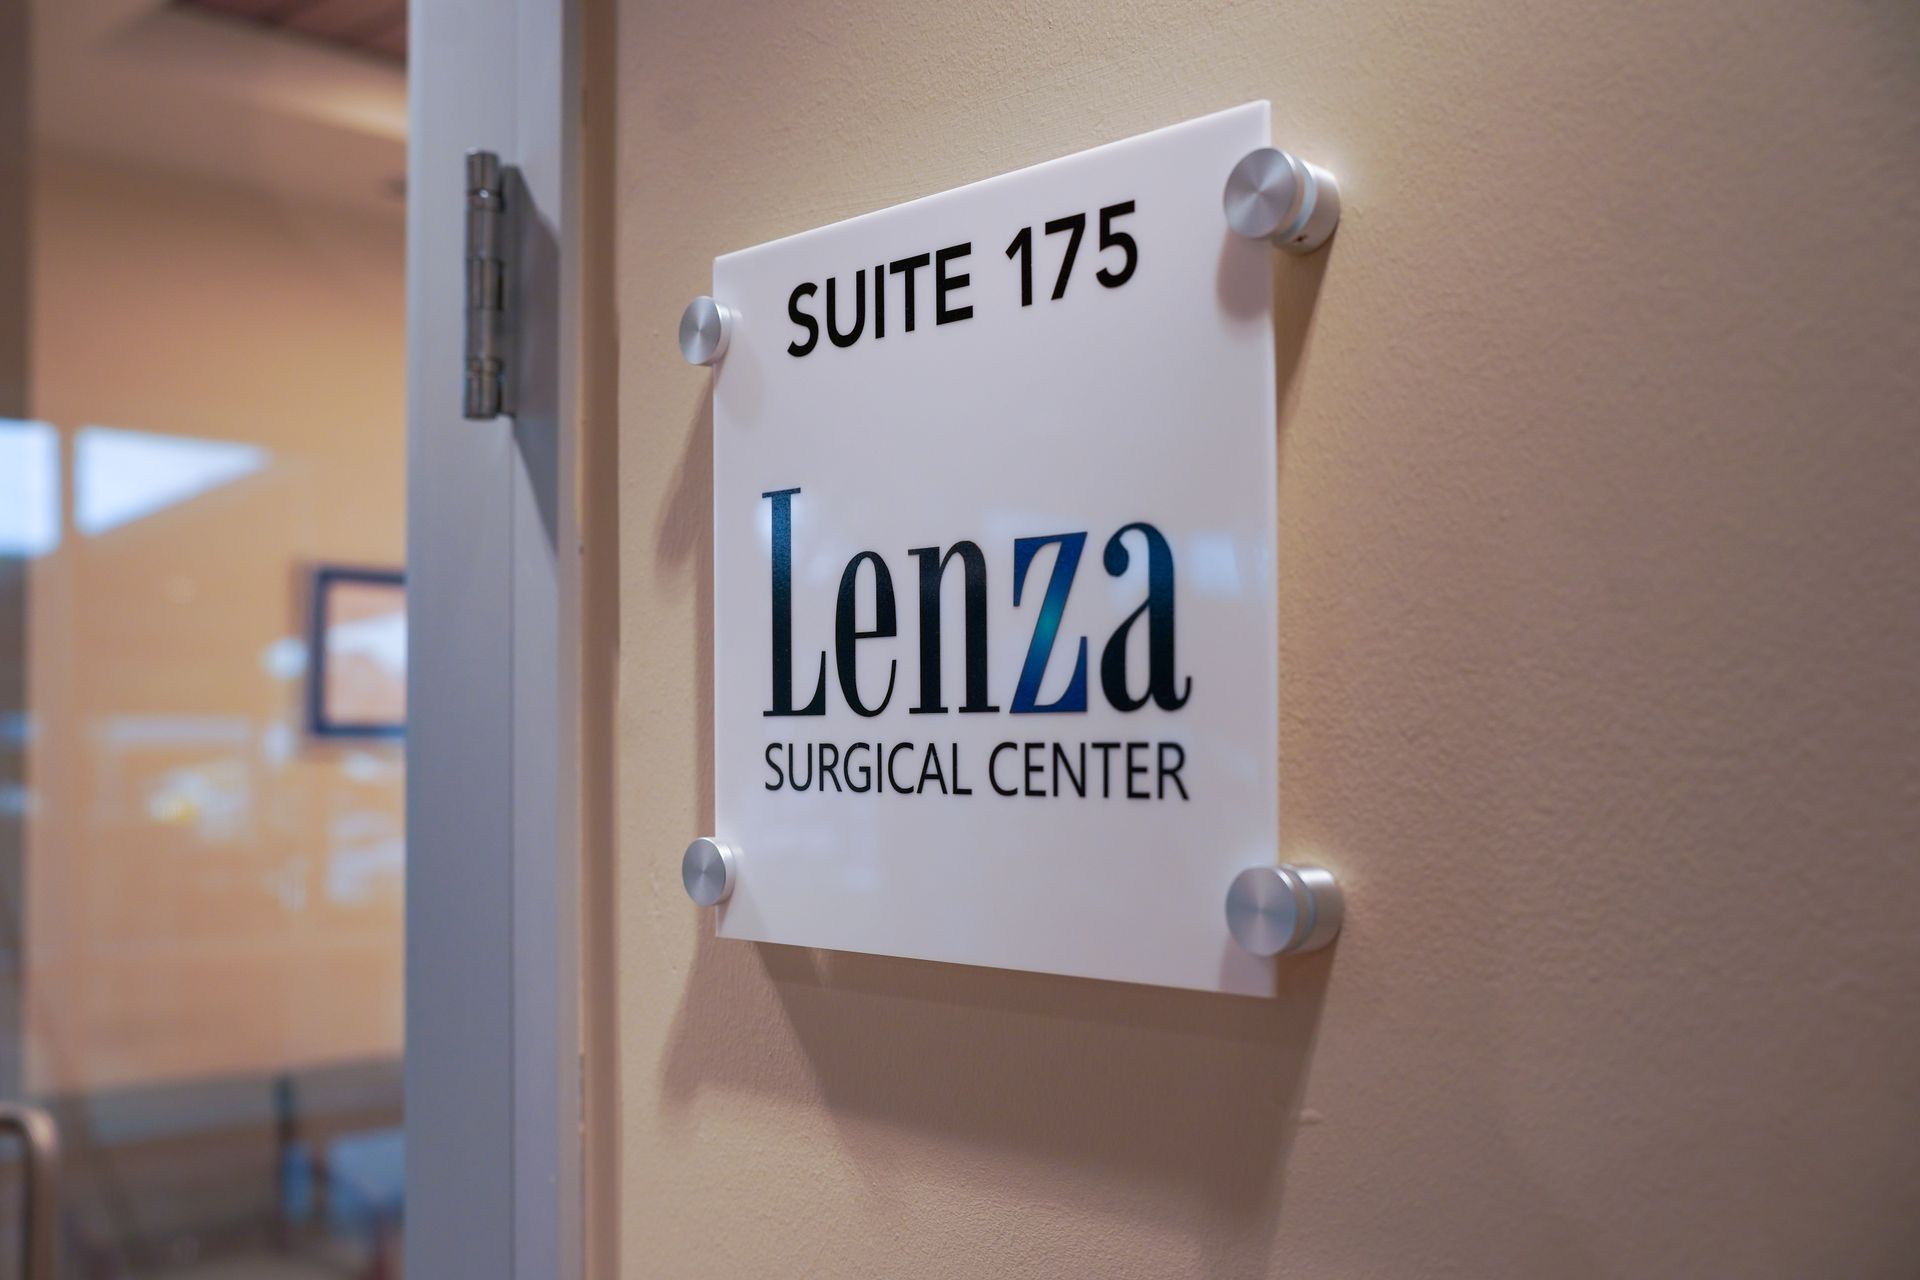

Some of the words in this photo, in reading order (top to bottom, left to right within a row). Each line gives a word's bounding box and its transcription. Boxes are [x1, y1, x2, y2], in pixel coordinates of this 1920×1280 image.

[786, 241, 974, 358] SUITE
[1004, 199, 1139, 308] 175
[761, 487, 1194, 718] Lenza
[764, 741, 973, 796] SURGICAL
[988, 741, 1191, 802] CENTER
